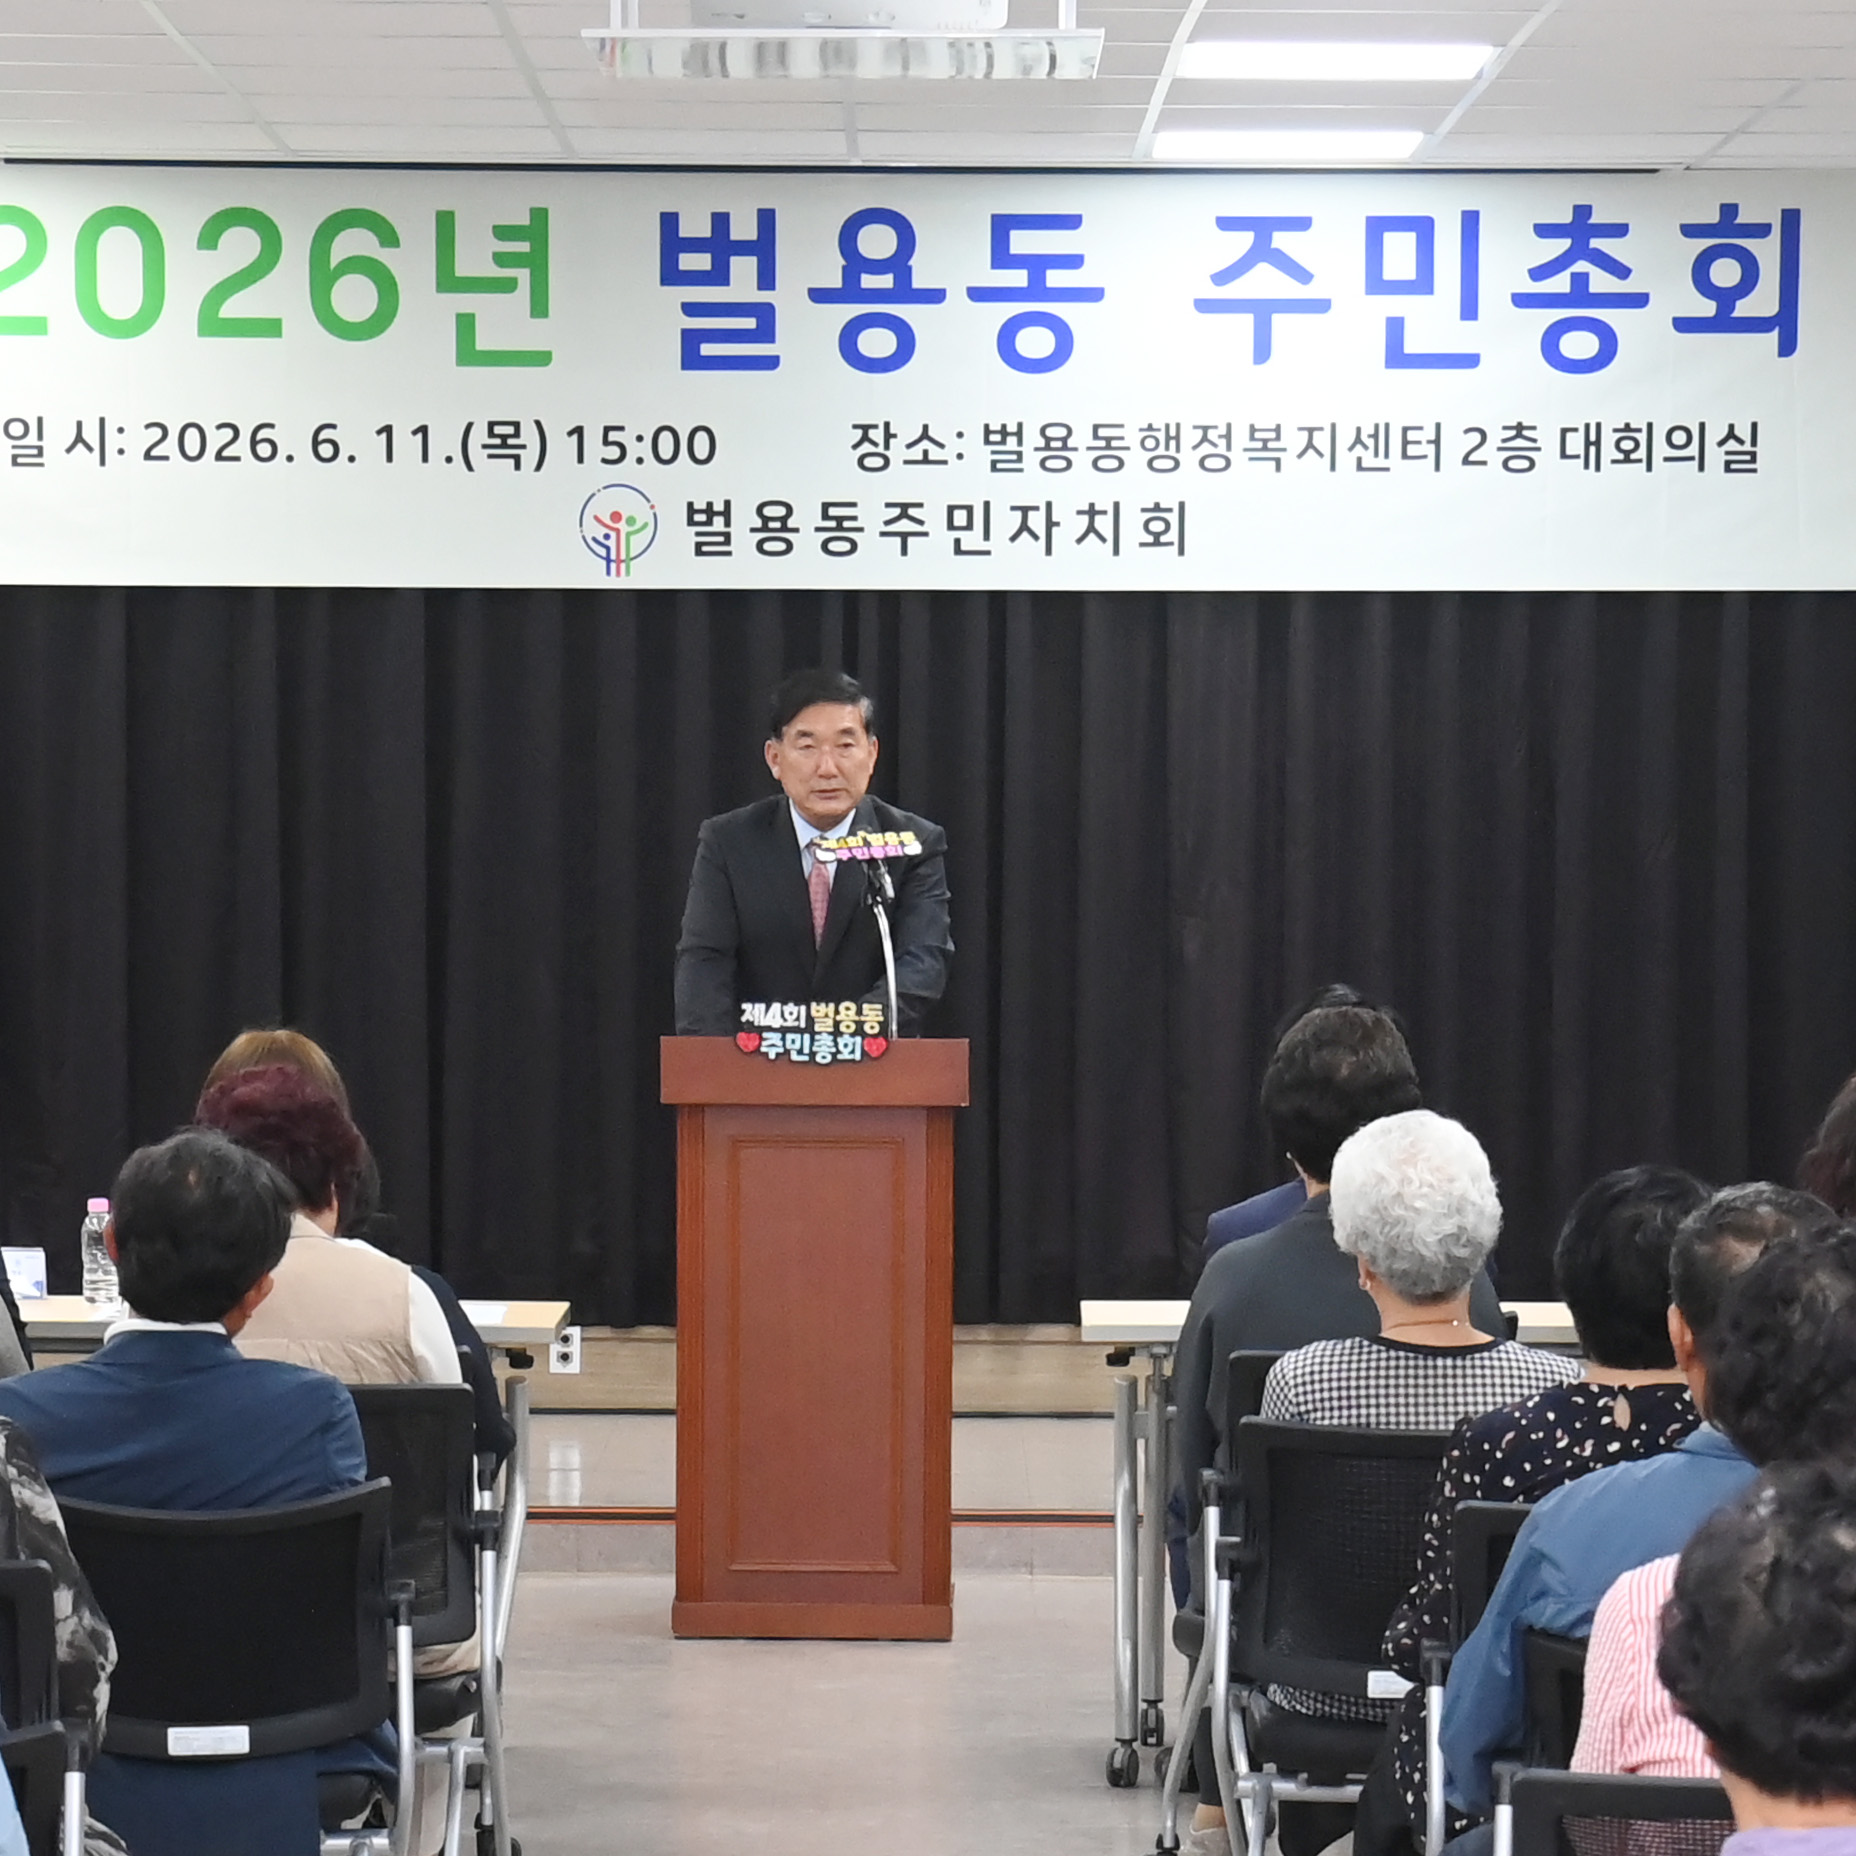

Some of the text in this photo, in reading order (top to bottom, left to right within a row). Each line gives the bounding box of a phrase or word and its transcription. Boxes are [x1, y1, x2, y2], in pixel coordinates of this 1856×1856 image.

[658, 207, 1105, 374] 벌용동
[1193, 203, 1802, 375] 주민총회
[566, 425, 717, 466] 15:00
[850, 421, 1758, 474] 장소: 벌용동행정복지센터 2층 대회의실
[686, 499, 1186, 557] 벌용동주민자치회
[740, 1001, 885, 1035] 제4회 벌용동
[760, 1031, 863, 1064] 주민총회
